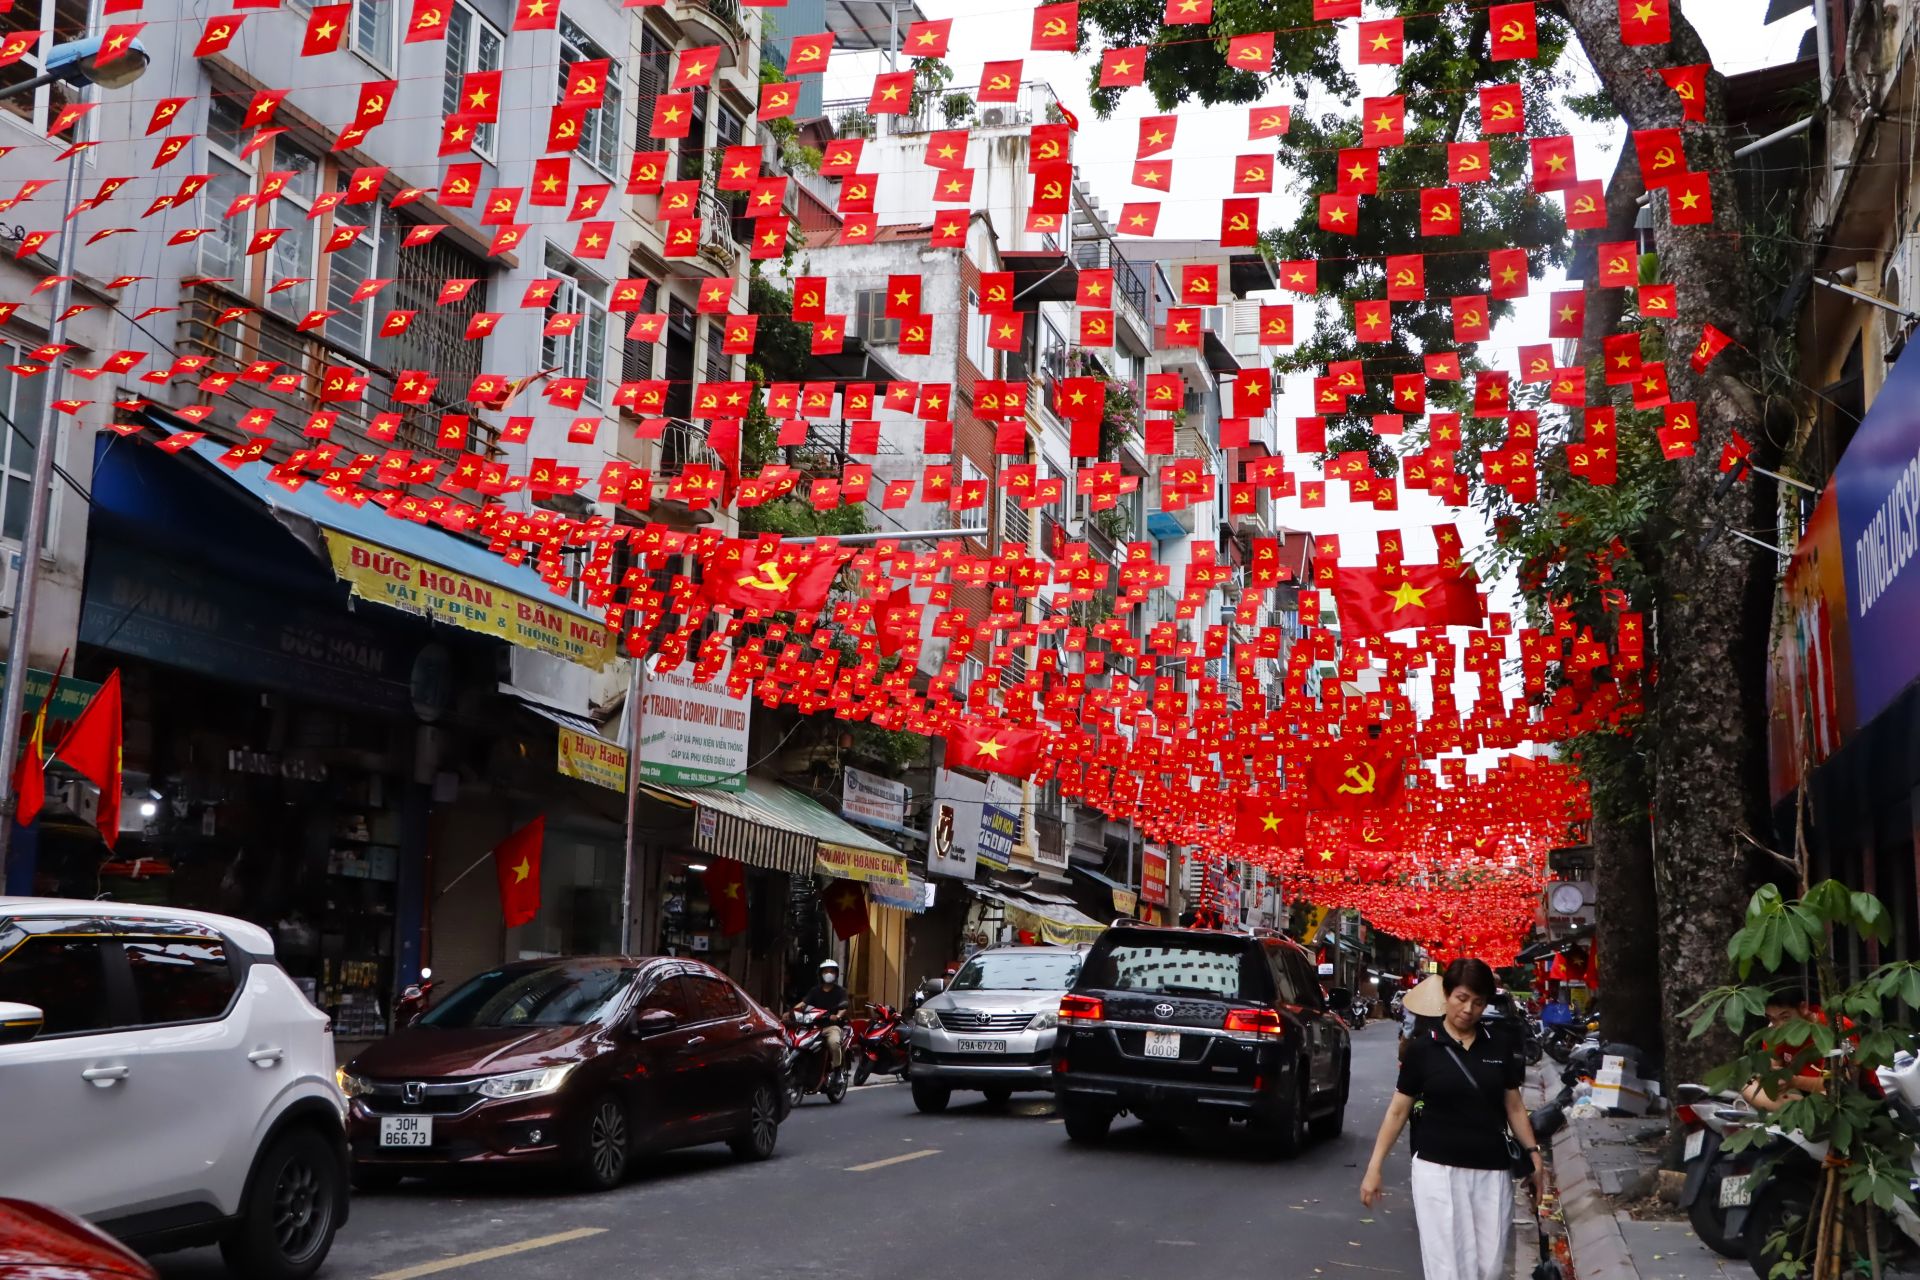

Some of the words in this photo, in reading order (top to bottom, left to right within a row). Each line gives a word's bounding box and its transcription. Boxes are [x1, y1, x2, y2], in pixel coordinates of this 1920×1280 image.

[1856, 447, 1920, 618] DONGLUCSP
[351, 545, 410, 582] ĐỨC
[419, 569, 493, 608] HOÀN
[517, 600, 563, 634] BẢN
[650, 694, 683, 720] TRADING
[683, 701, 718, 727] COMPANY
[719, 709, 746, 731] LIMITED
[575, 735, 597, 760] Huy
[599, 744, 625, 768] Hạnh
[385, 1132, 426, 1145] 866.73
[396, 1118, 418, 1131] 30H
